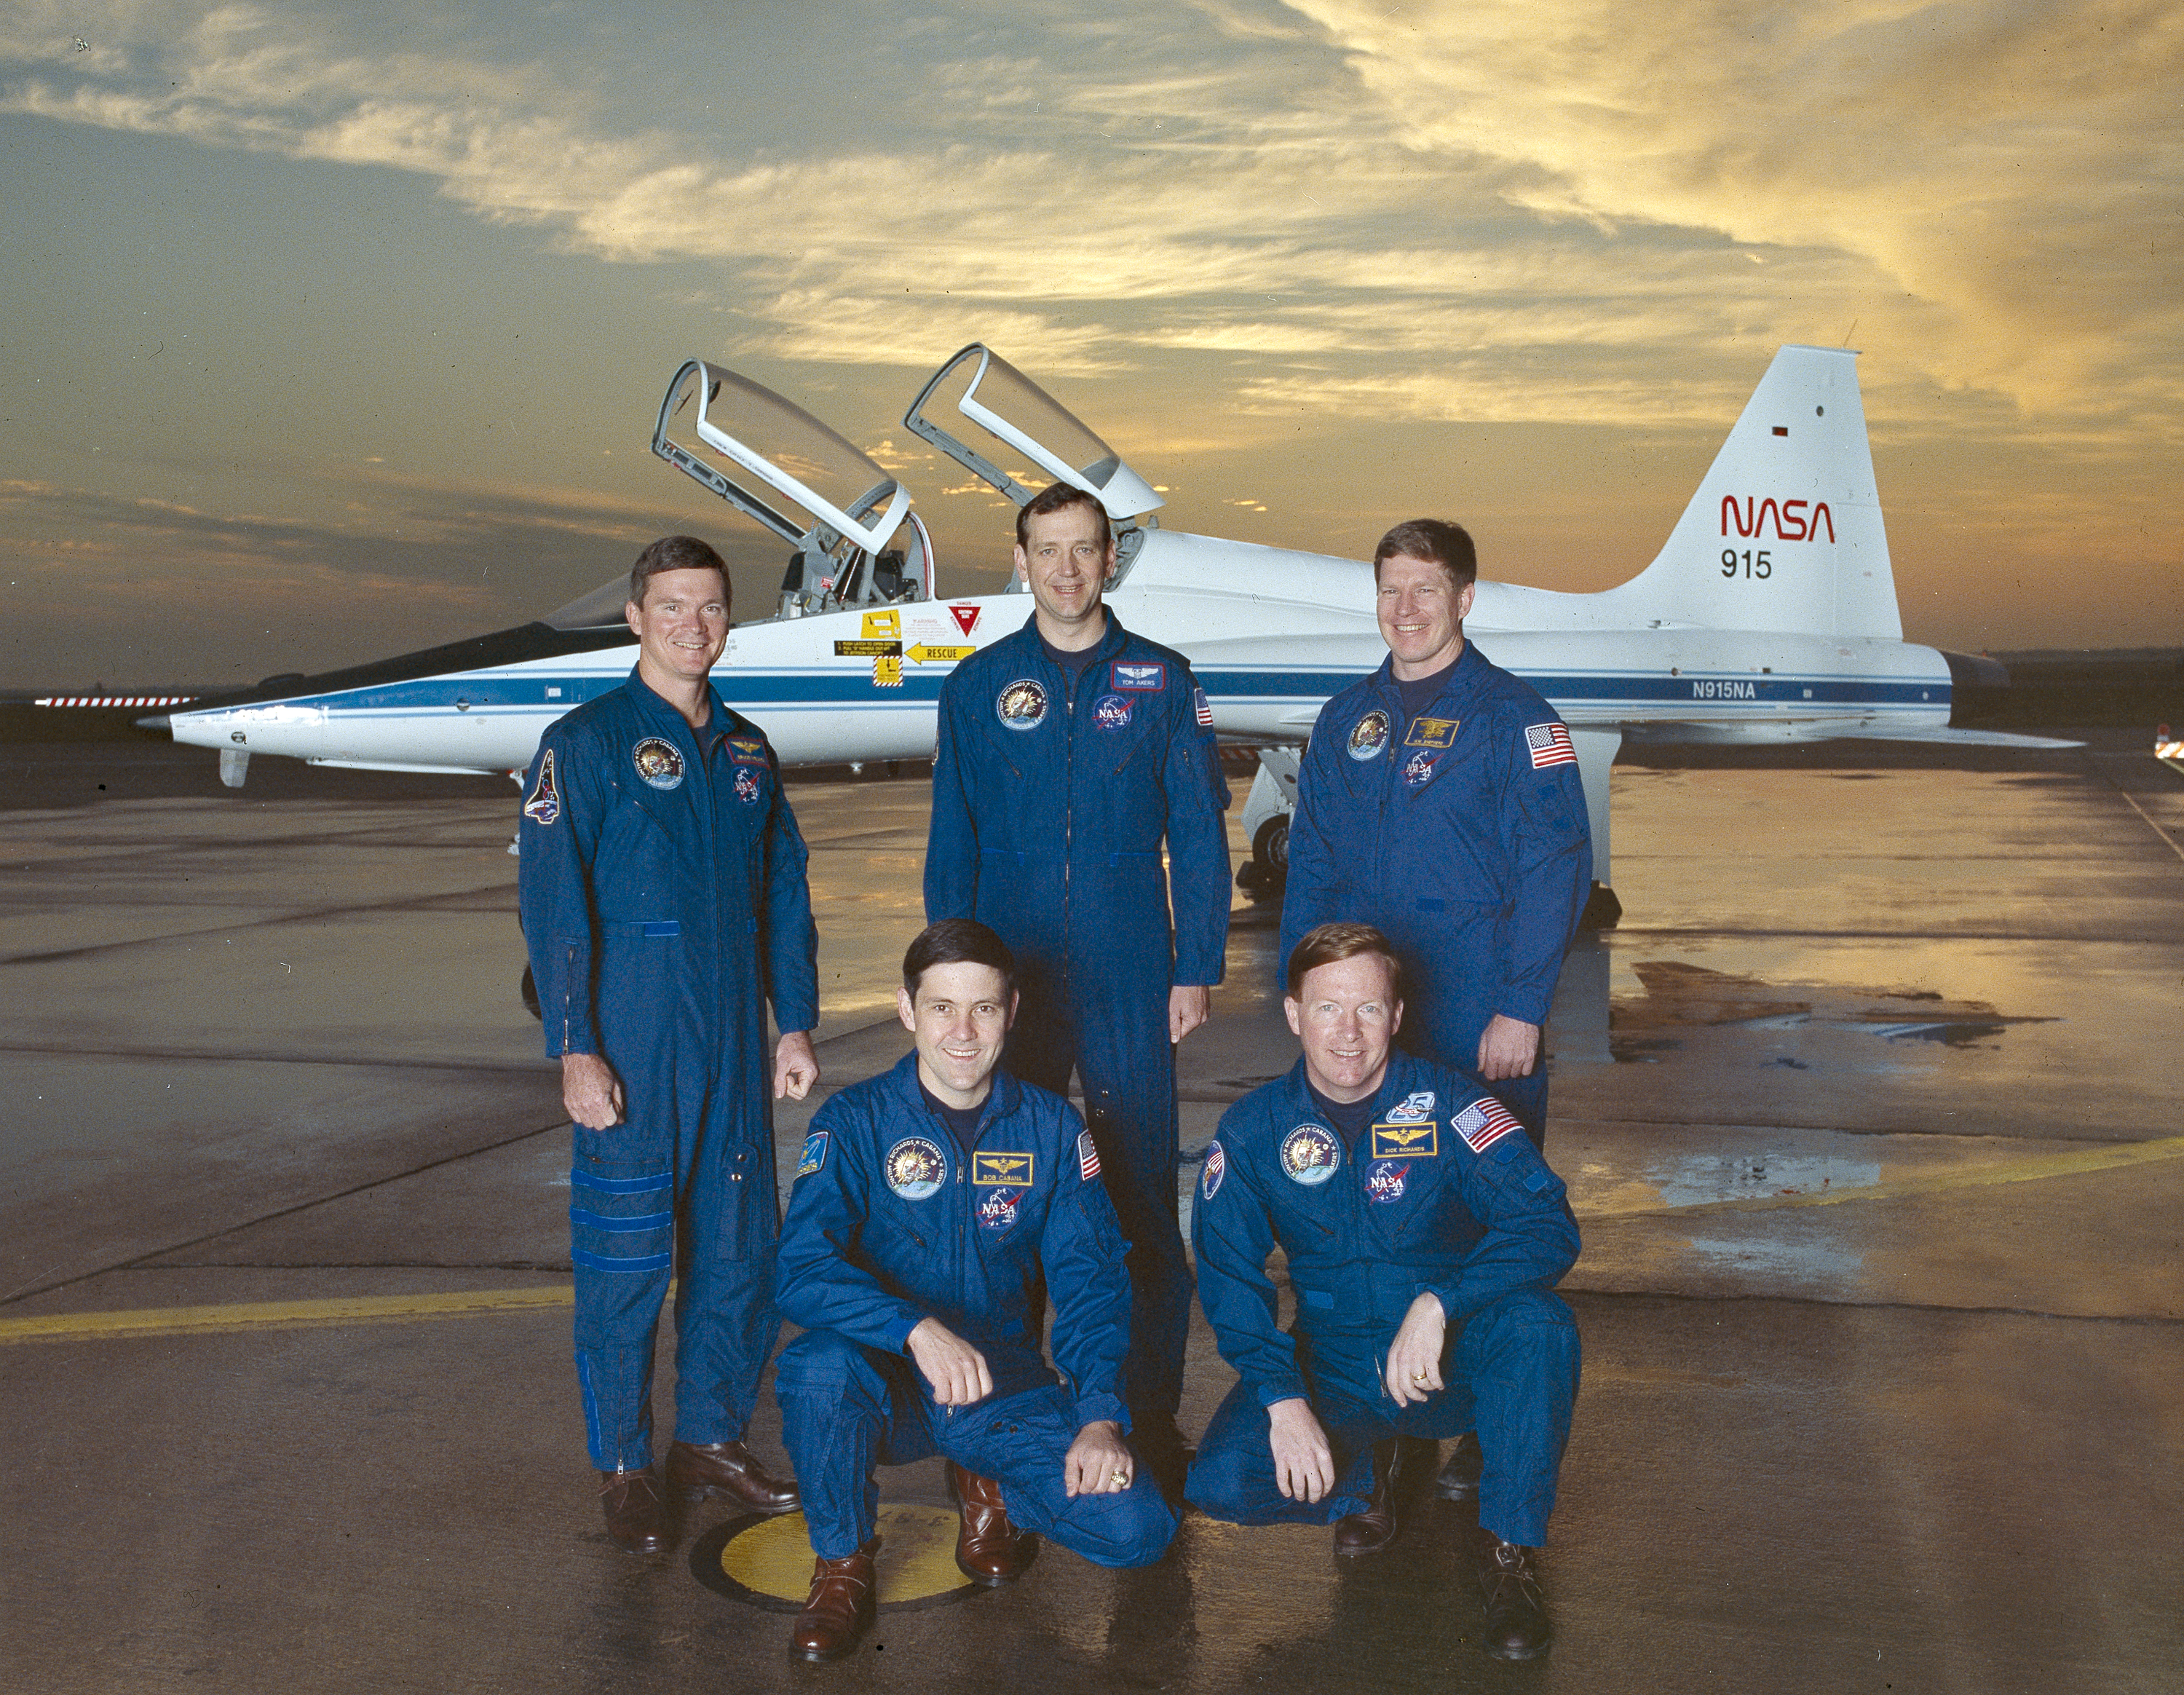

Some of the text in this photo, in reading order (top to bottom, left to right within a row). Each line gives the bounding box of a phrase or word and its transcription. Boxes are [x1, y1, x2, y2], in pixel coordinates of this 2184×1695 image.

[1721, 495, 1835, 544] NASA
[1721, 549, 1772, 580] 915
[927, 649, 957, 658] RESCUE
[1693, 681, 1756, 699] N915NA
[1099, 709, 1128, 719] NASA
[659, 740, 678, 757] CABANA
[1284, 1127, 1306, 1148] RICHARDS
[1312, 1127, 1333, 1144] CABANA
[889, 1139, 914, 1159] RICHARDS
[921, 1141, 942, 1161] CABANA
[1369, 1177, 1404, 1188] NASA
[982, 1203, 1017, 1214] NASA
